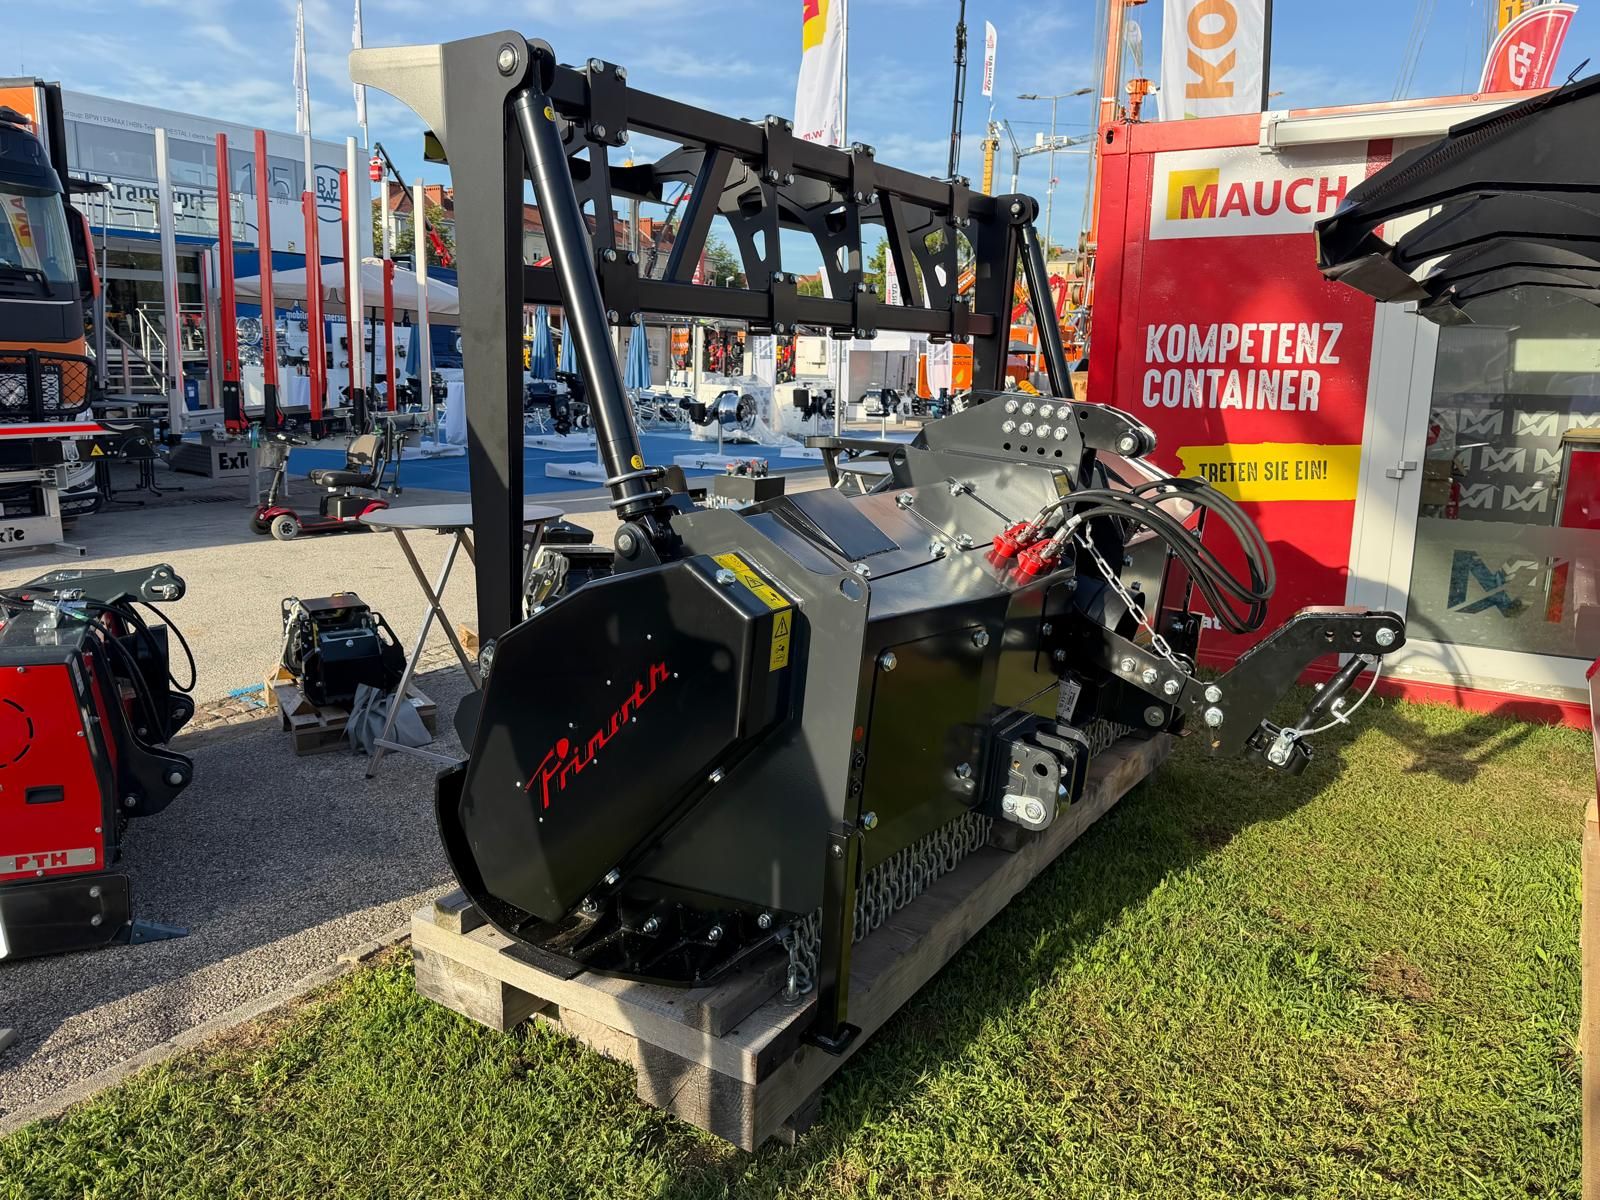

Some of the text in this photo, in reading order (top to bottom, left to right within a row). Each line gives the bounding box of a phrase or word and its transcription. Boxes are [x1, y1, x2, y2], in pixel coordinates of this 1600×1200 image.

[1180, 175, 1348, 220] MAUCH
[1145, 323, 1344, 364] KOMPETENZ
[1142, 368, 1321, 412] CONTAINER
[1199, 460, 1328, 482] TRETEN SIE EIN!
[15, 852, 67, 870] PTH
